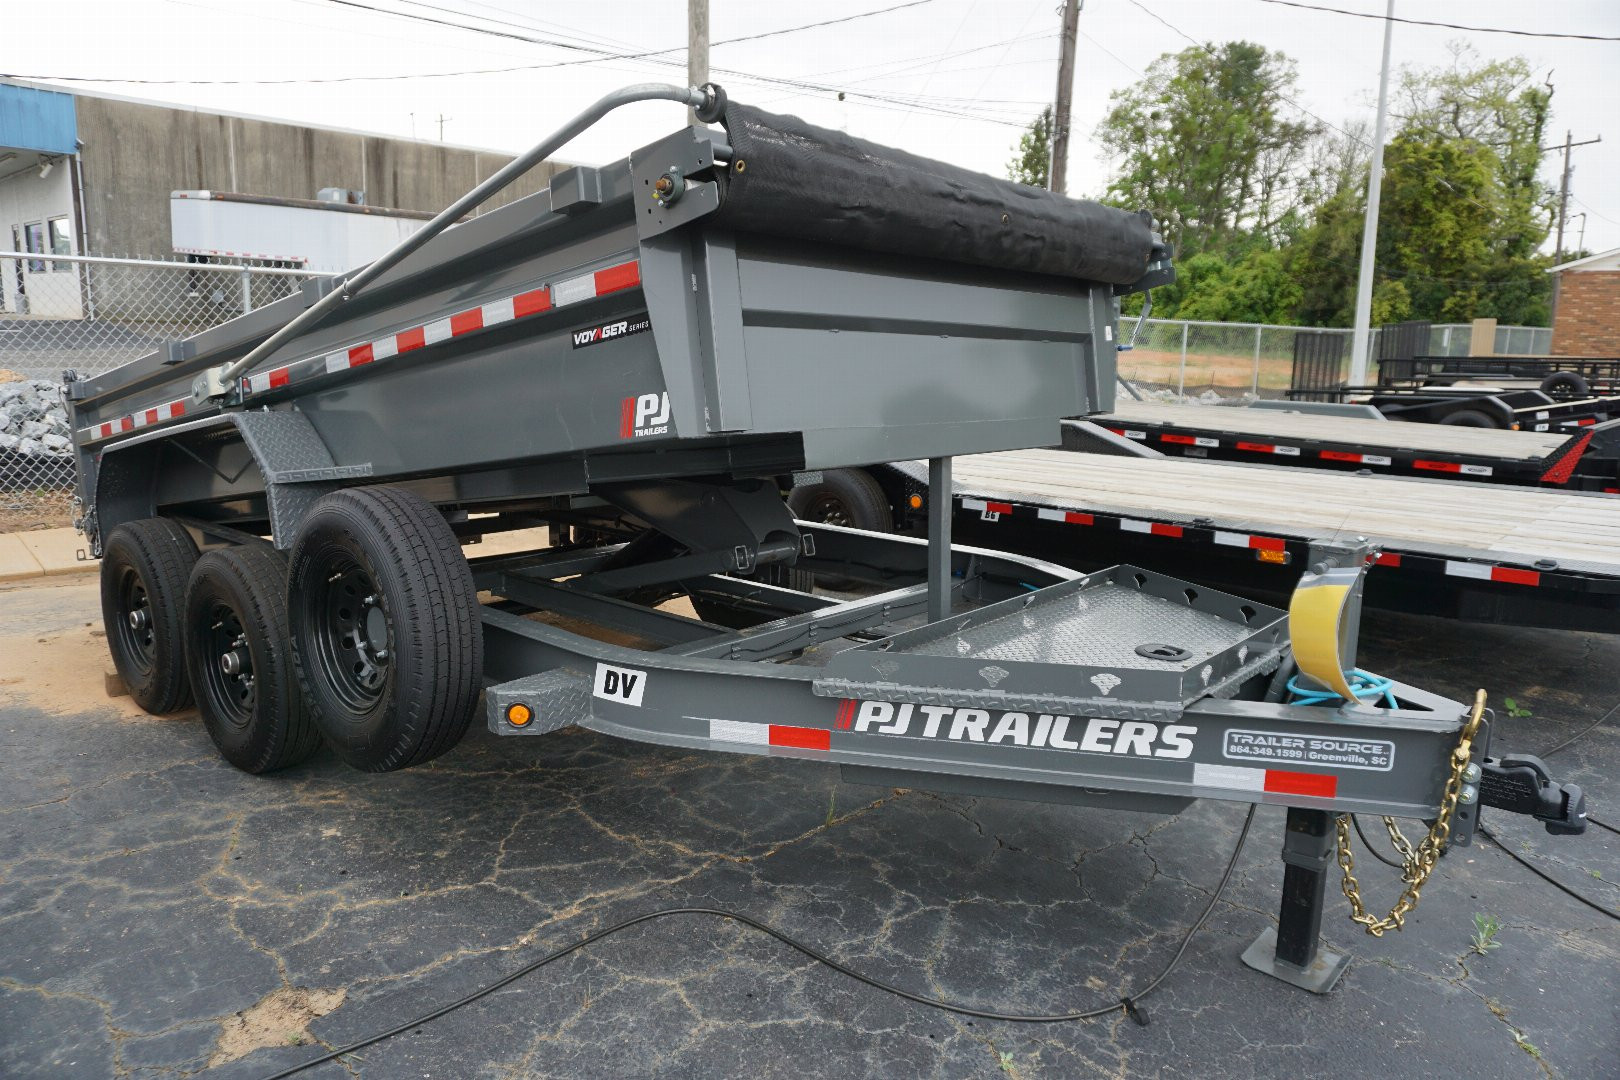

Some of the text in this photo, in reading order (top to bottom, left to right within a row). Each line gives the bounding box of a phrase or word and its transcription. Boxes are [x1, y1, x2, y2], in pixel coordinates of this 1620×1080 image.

[573, 321, 649, 345] VOYAGER SERIES
[635, 391, 671, 428] PJ
[634, 425, 668, 437] TRAILERS
[603, 669, 638, 699] DV
[854, 700, 1198, 759] PJ TRAILERS
[1229, 745, 1388, 766] 864.349.1599 Greenville, SC
[1231, 734, 1384, 754] TRAILER SOURCE
